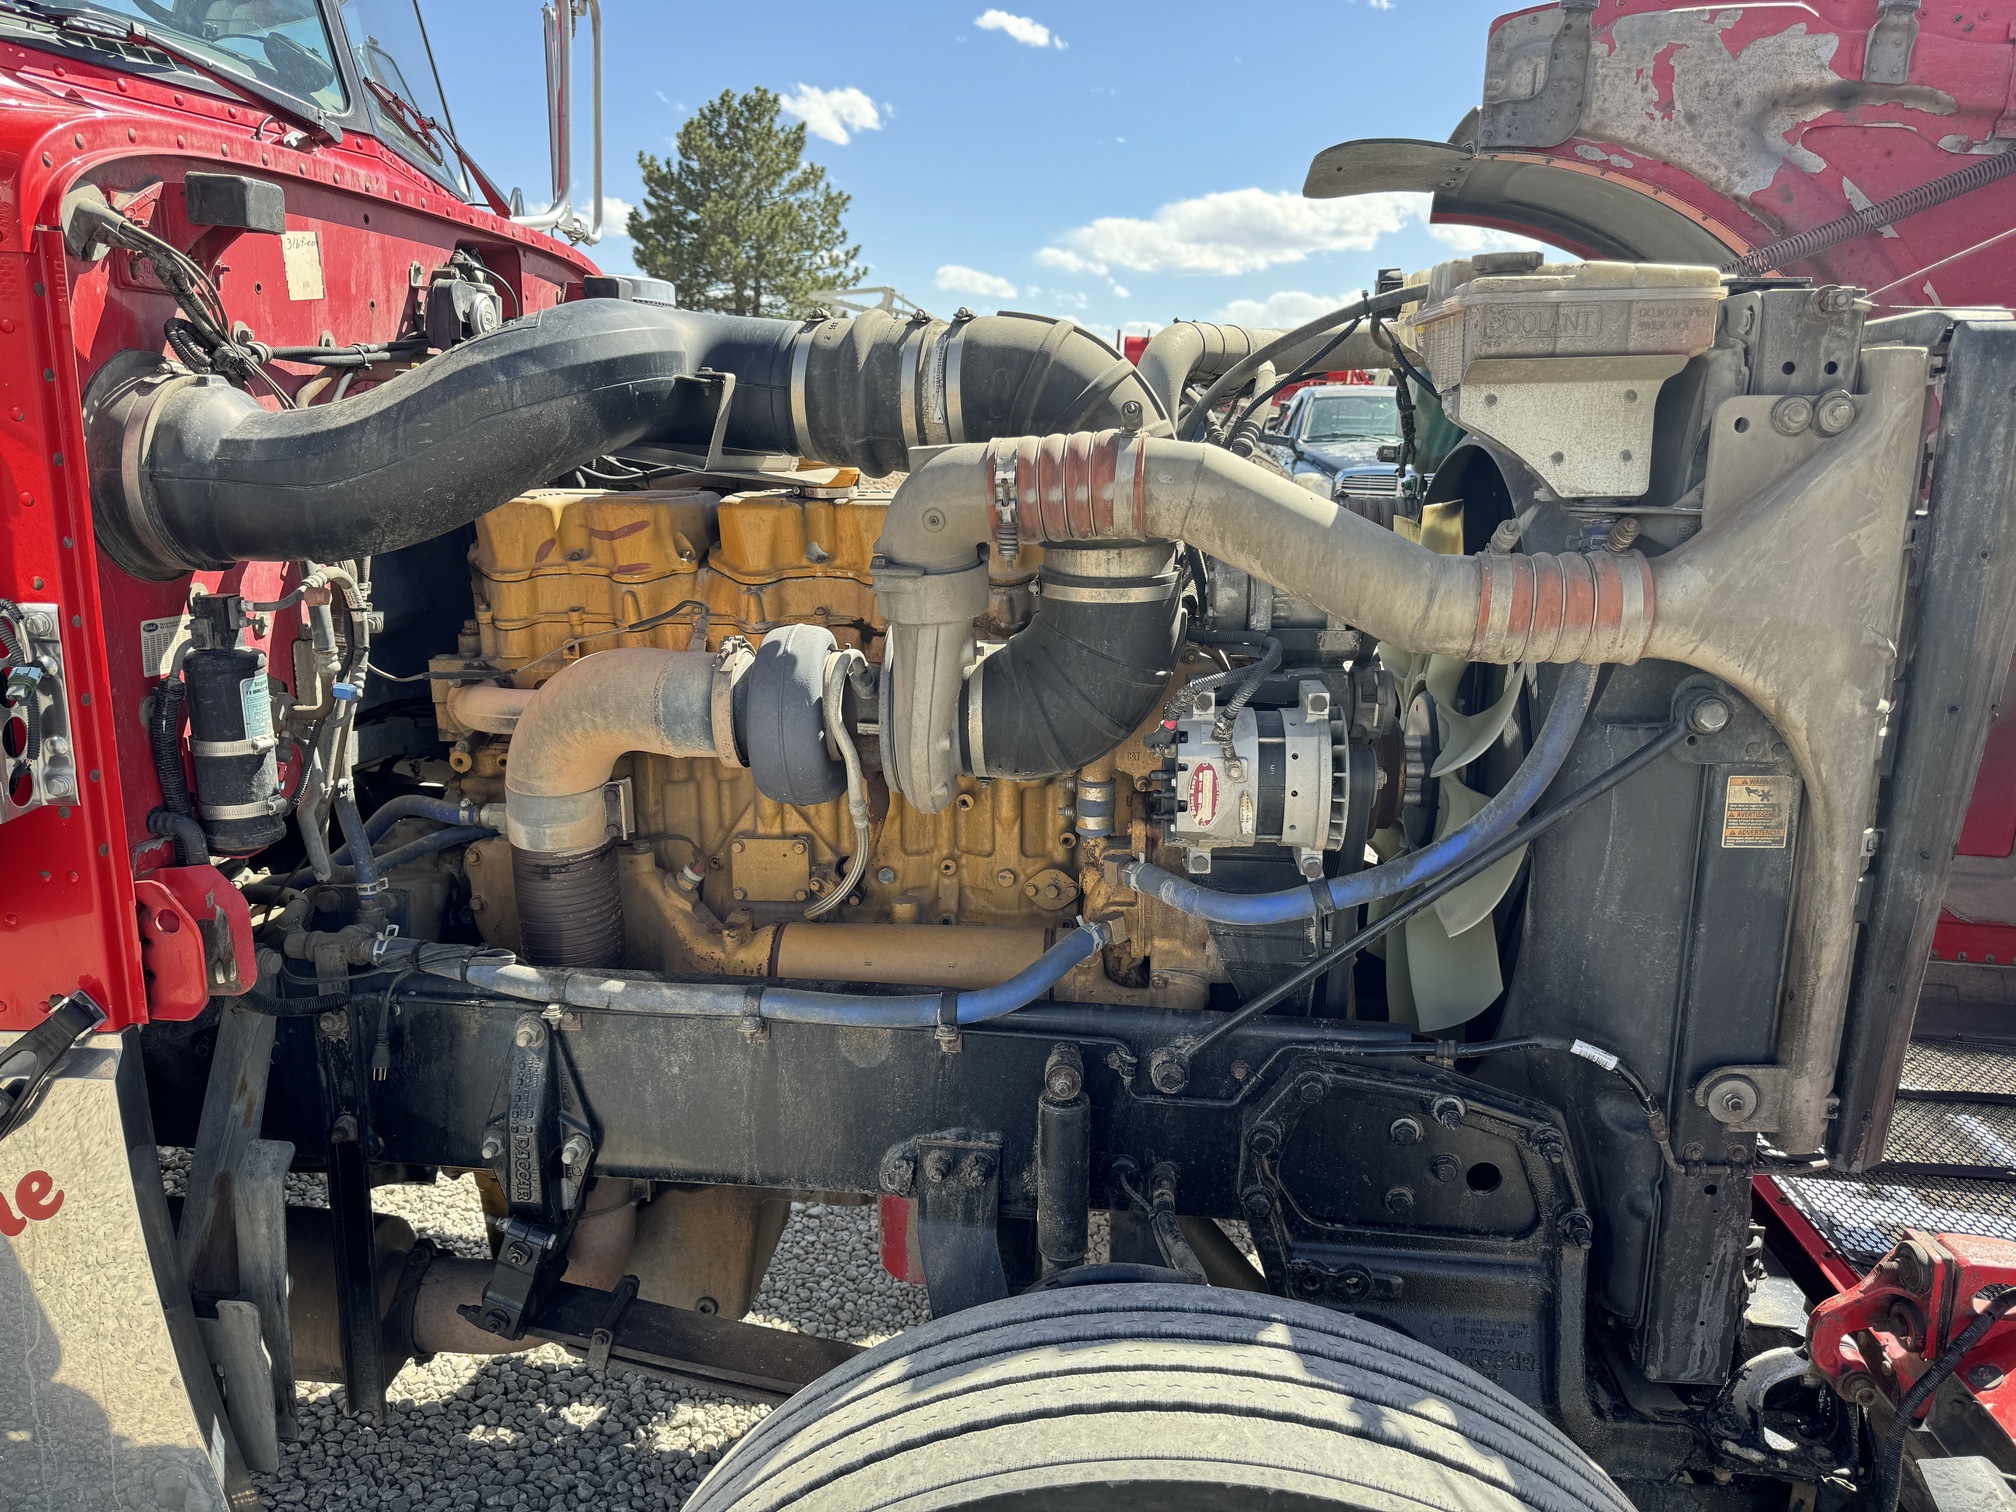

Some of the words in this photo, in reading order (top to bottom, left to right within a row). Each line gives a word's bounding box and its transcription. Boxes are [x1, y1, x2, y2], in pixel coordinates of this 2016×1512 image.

[1489, 310, 1596, 335] COOLANT
[515, 1135, 532, 1201] PACCAR
[1446, 1346, 1535, 1372] PACCAR
